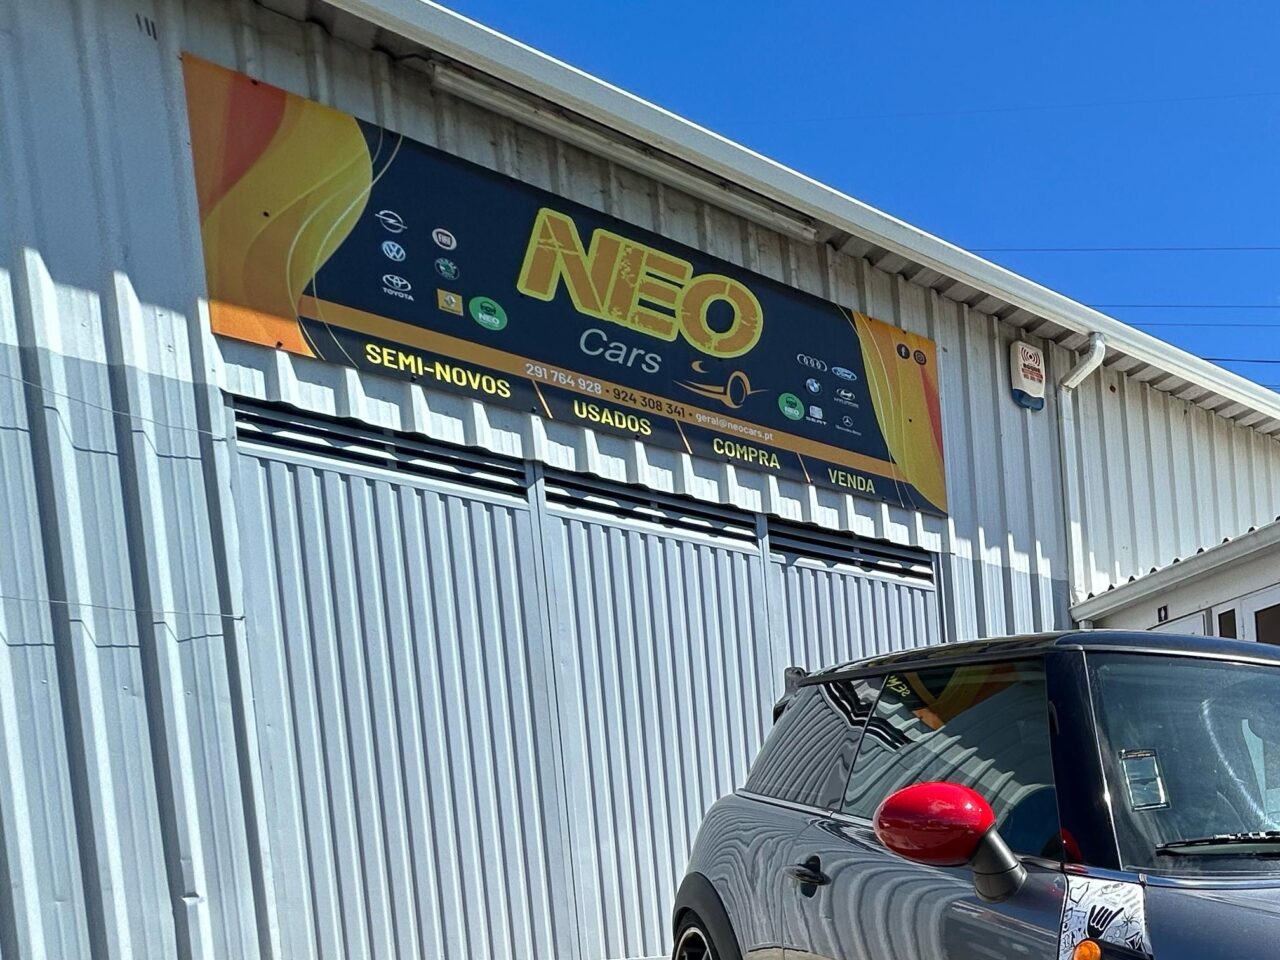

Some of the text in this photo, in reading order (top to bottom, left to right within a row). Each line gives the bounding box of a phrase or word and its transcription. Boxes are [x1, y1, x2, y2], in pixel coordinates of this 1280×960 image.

[382, 286, 414, 301] TOYOTA
[517, 207, 764, 359] NEO
[365, 343, 512, 399] SEMI-NOVOS
[579, 328, 662, 374] Cars
[525, 362, 774, 442] 291 764 928 924 308 341 geral@neocars.pt
[573, 400, 652, 436] USADOS
[713, 437, 781, 469] COMPRA
[828, 468, 876, 494] VENDA
